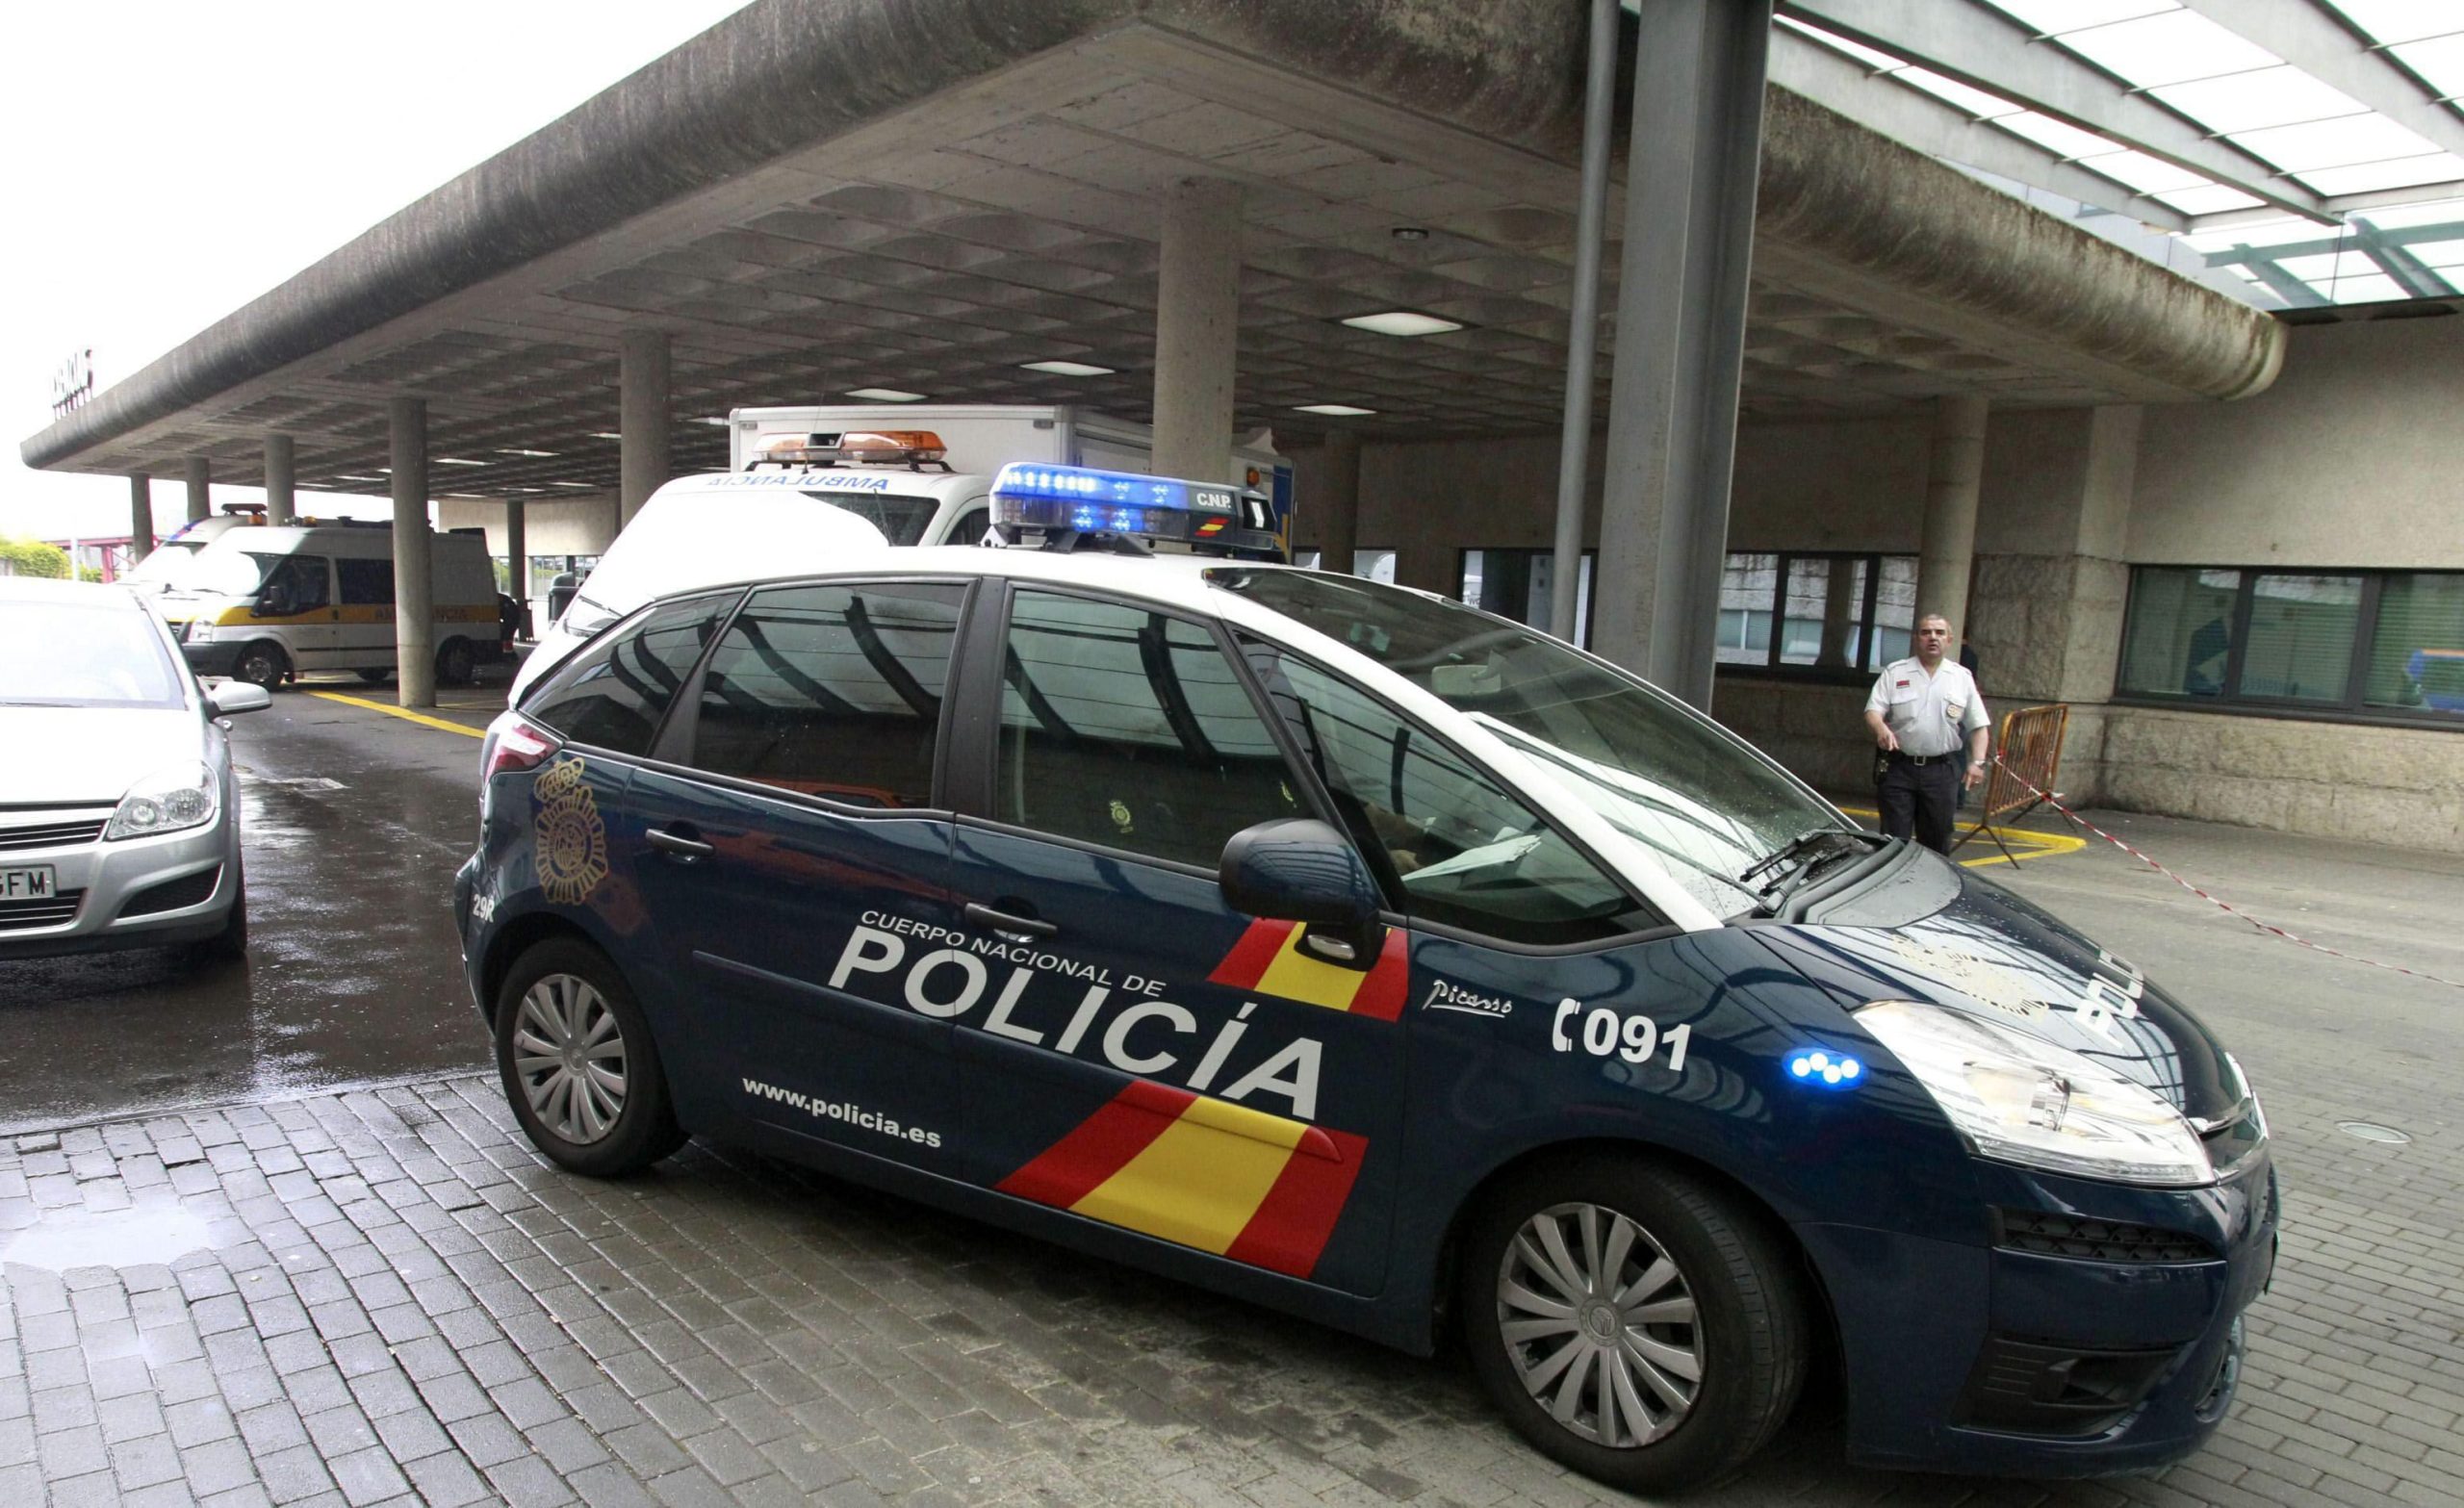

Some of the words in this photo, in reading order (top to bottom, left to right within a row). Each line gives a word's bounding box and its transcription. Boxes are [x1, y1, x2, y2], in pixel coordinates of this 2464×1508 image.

[1196, 492, 1232, 509] C.N.P.
[0, 871, 46, 896] FM
[473, 893, 495, 923] 29R
[860, 910, 965, 947] CUERPO
[970, 937, 1113, 985] NACIONAL
[1121, 975, 1167, 998] DE
[828, 925, 1324, 1121] POLICÍA
[1422, 979, 1512, 1018] Picasso
[1583, 1009, 1691, 1072] 091
[742, 1078, 941, 1148] www.policia.es
